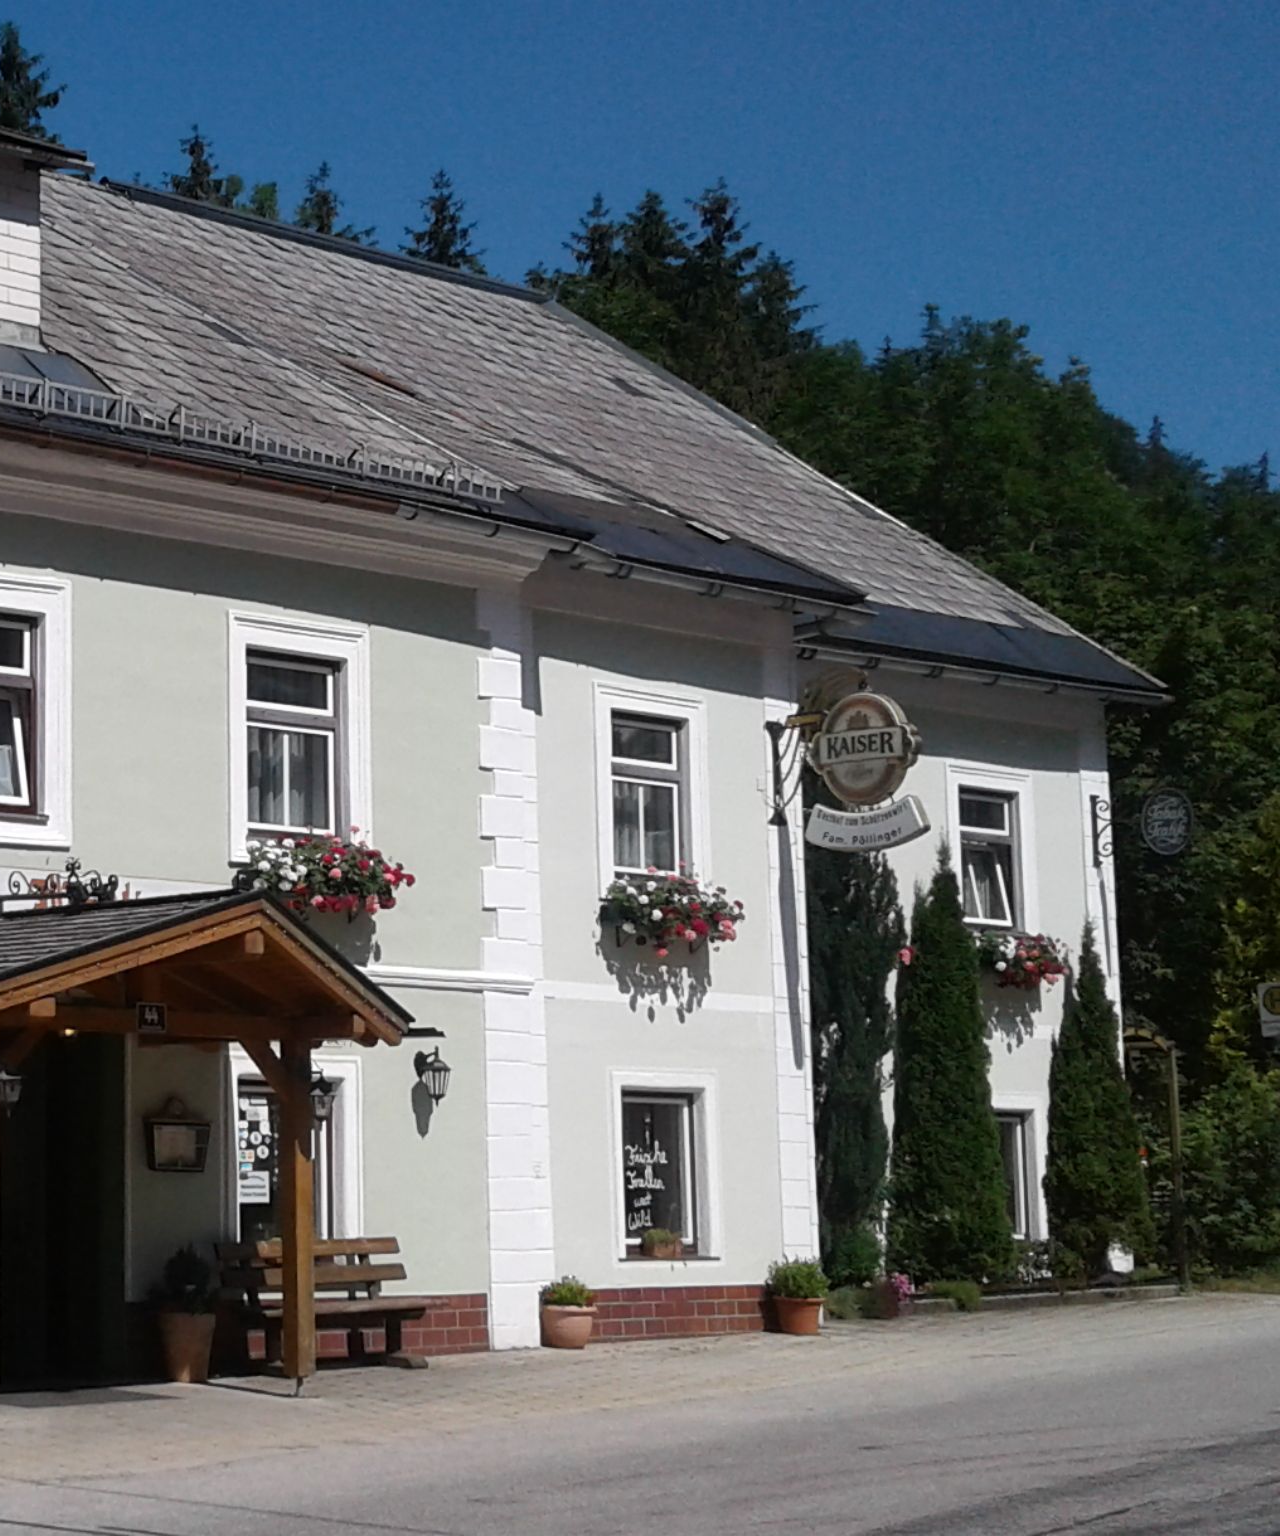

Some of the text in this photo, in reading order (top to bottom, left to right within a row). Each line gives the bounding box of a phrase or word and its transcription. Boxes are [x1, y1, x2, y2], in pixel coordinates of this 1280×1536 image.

[826, 731, 895, 760] KAISER
[822, 826, 902, 846] Fam. Pöllinger
[144, 1006, 159, 1024] 44
[625, 1140, 669, 1166] Frische
[633, 1192, 653, 1208] und
[628, 1209, 654, 1231] Wild
